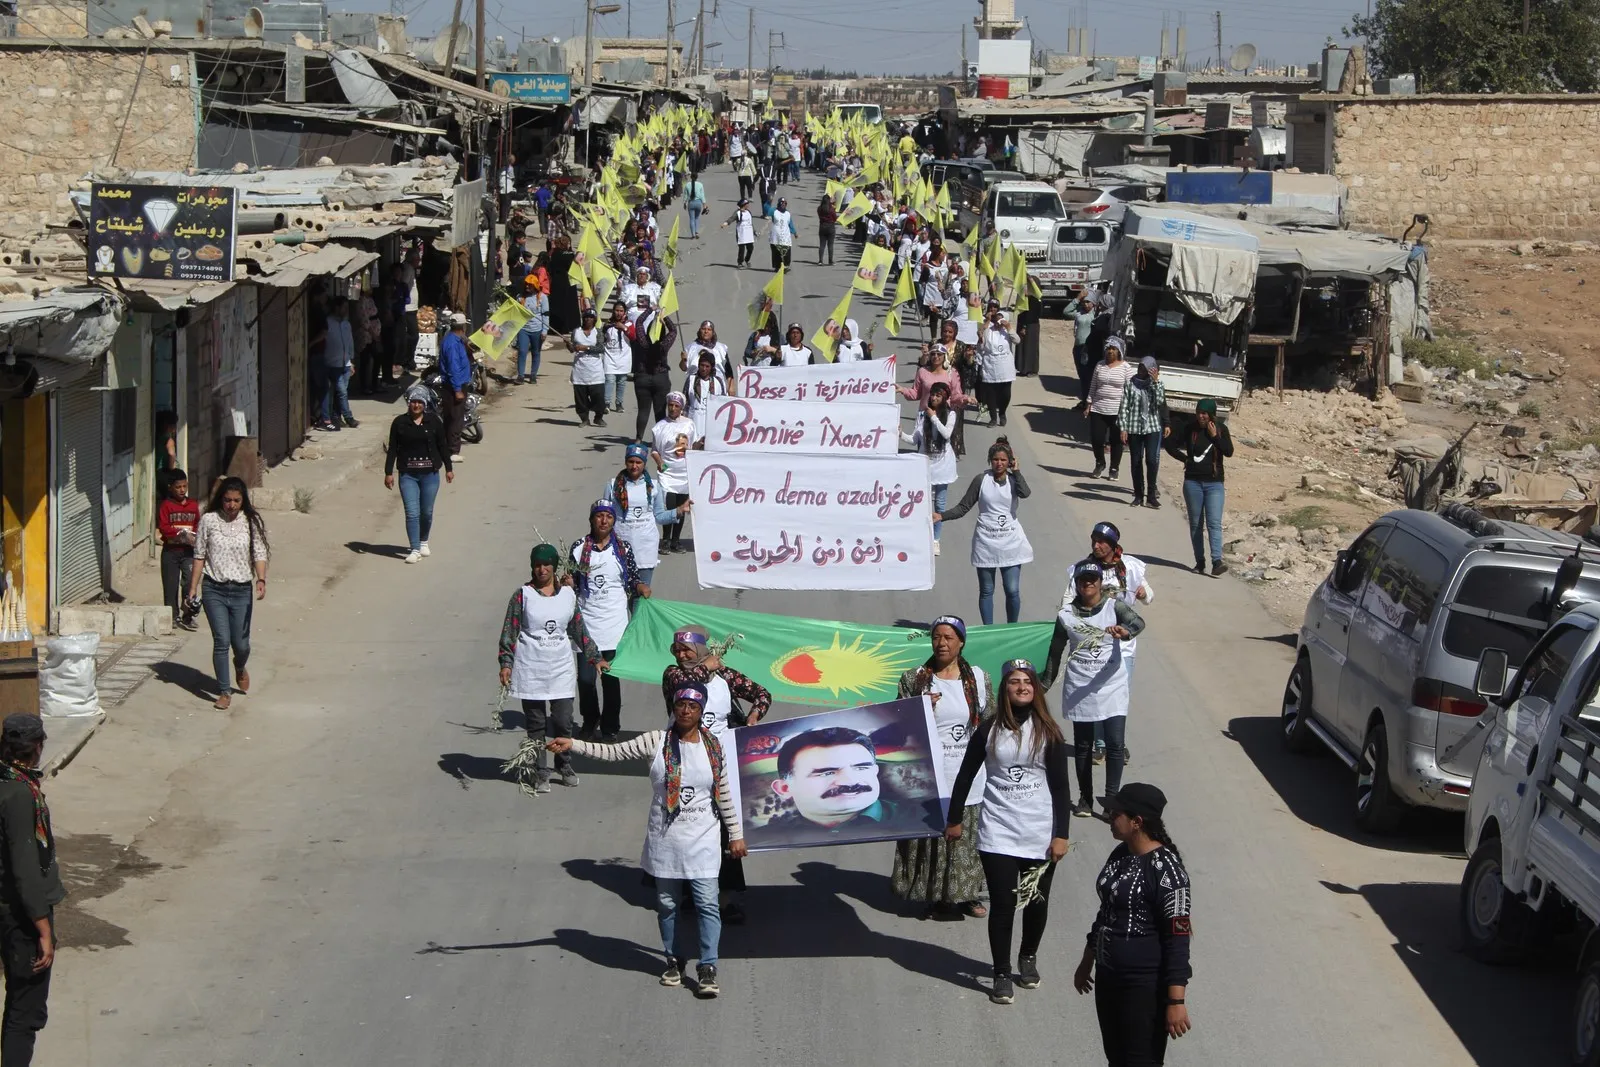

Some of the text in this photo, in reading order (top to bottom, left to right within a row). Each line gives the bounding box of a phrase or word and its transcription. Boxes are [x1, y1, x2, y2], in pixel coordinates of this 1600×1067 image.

[97, 187, 132, 199] محمد
[176, 192, 228, 211] مجوهرات
[739, 369, 787, 399] Bese
[698, 463, 766, 505] Dem
[775, 470, 827, 506] dema
[812, 535, 845, 566] زمن
[850, 536, 884, 565] زمن
